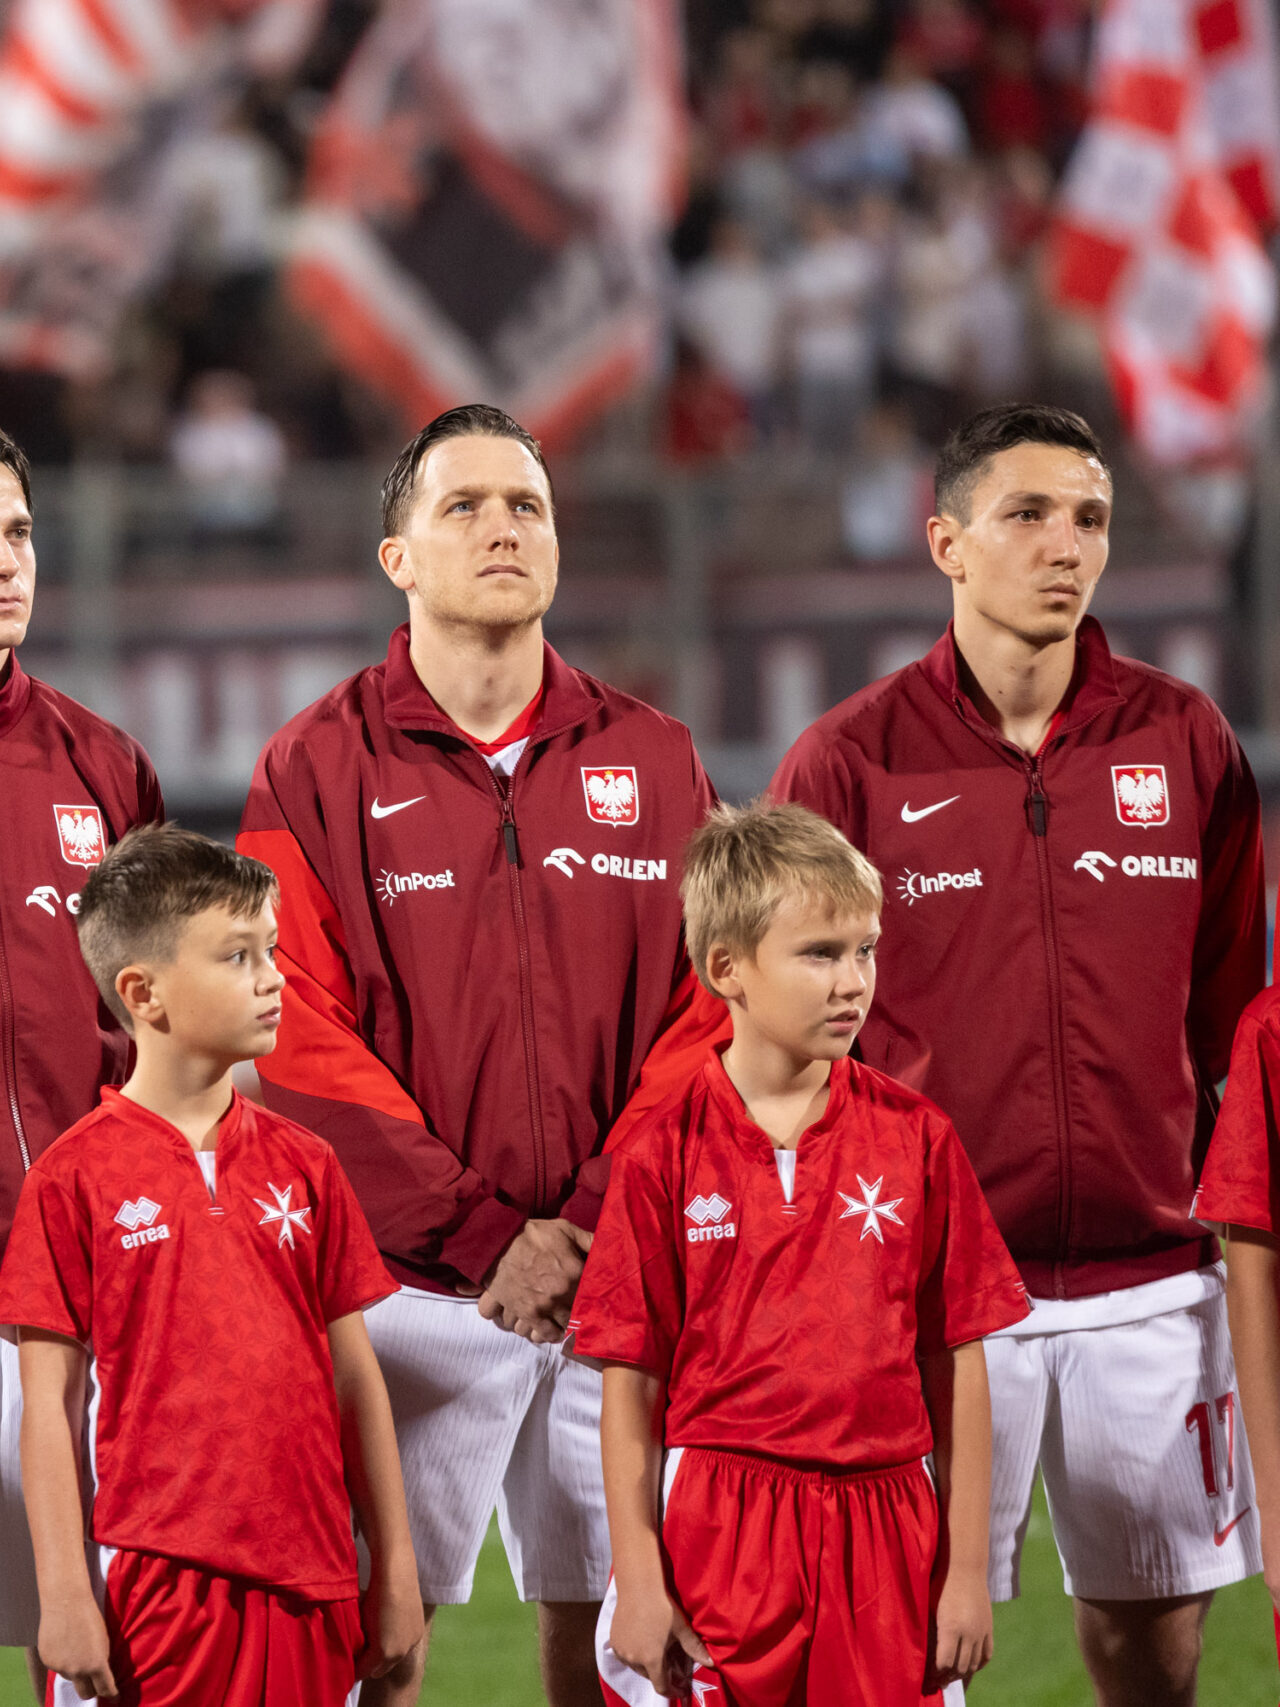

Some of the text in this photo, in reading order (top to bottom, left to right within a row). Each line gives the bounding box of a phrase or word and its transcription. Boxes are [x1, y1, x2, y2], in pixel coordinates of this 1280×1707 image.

[591, 853, 667, 880] ORLEN
[1121, 855, 1197, 880] ORLEN
[394, 869, 455, 892] InPost
[920, 868, 983, 894] InPost
[120, 1224, 170, 1249] errea
[687, 1222, 736, 1242] errea
[1185, 1391, 1234, 1497] 17
